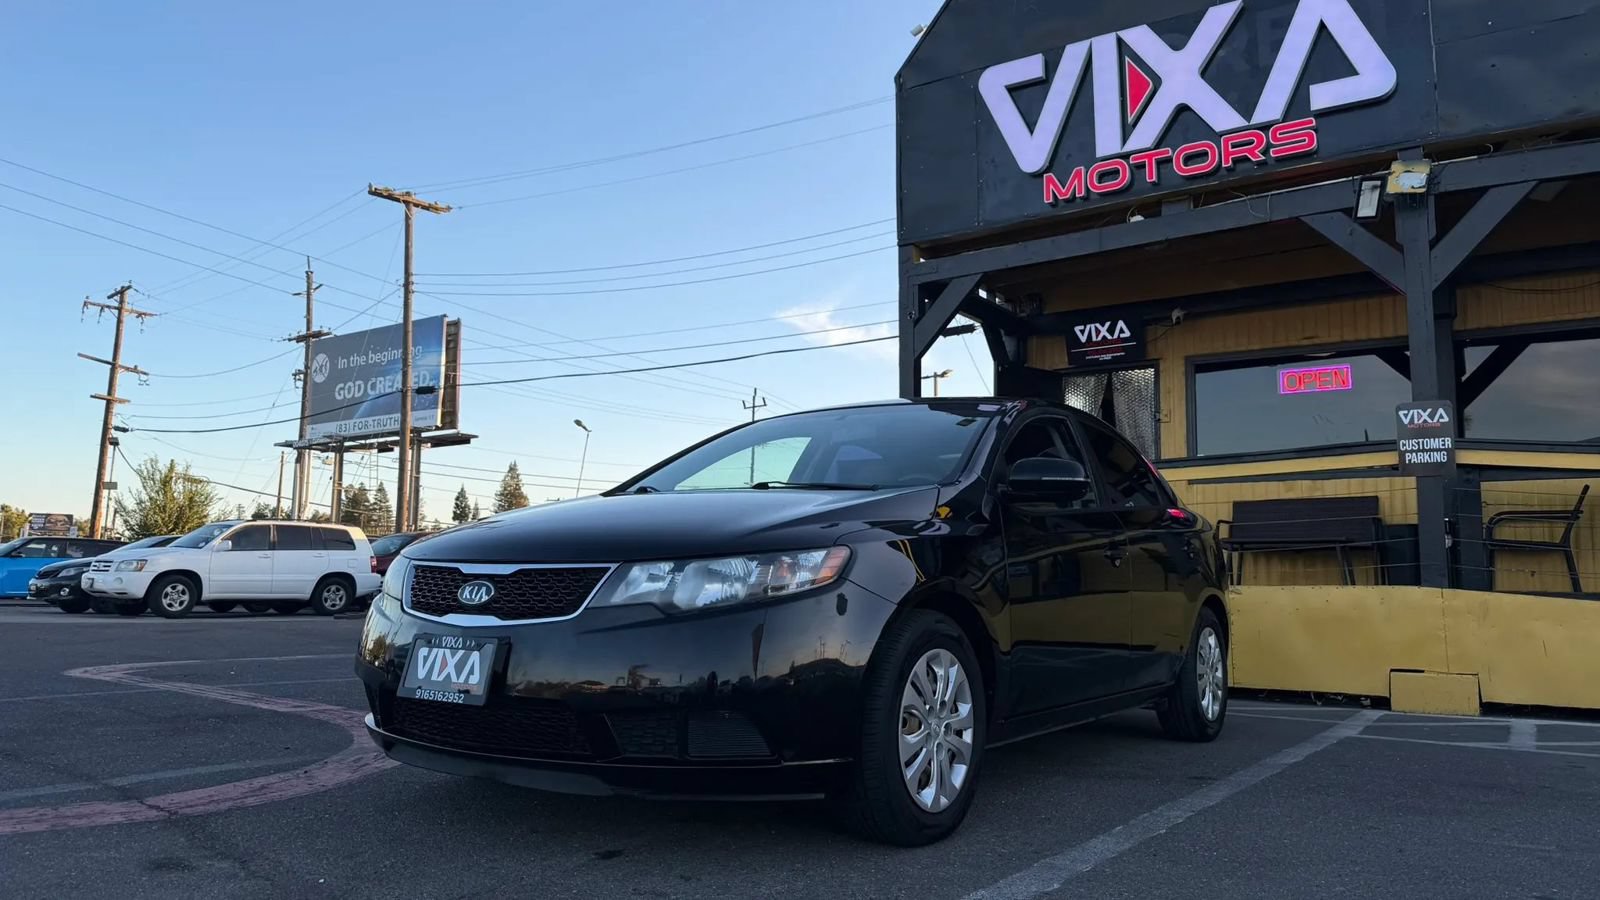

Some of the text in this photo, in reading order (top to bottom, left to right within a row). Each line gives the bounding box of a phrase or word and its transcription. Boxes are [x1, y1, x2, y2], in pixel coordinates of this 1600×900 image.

[978, 0, 1397, 173] VIXA
[1043, 117, 1318, 204] MOTORS
[1073, 319, 1131, 343] VIXA
[338, 356, 348, 369] In
[349, 353, 366, 367] the
[1283, 367, 1348, 392] OPEN
[334, 379, 365, 401] GOD
[335, 424, 351, 434] (83)
[352, 415, 400, 432] FOR-TRUTH
[1398, 407, 1449, 425] VIXA
[1400, 437, 1452, 451] CUSTOMER
[1405, 451, 1447, 464] PARKING
[462, 585, 489, 602] KIA
[442, 635, 463, 649] VIXA
[417, 647, 480, 685] VIXA
[415, 688, 465, 704] 9165162952
